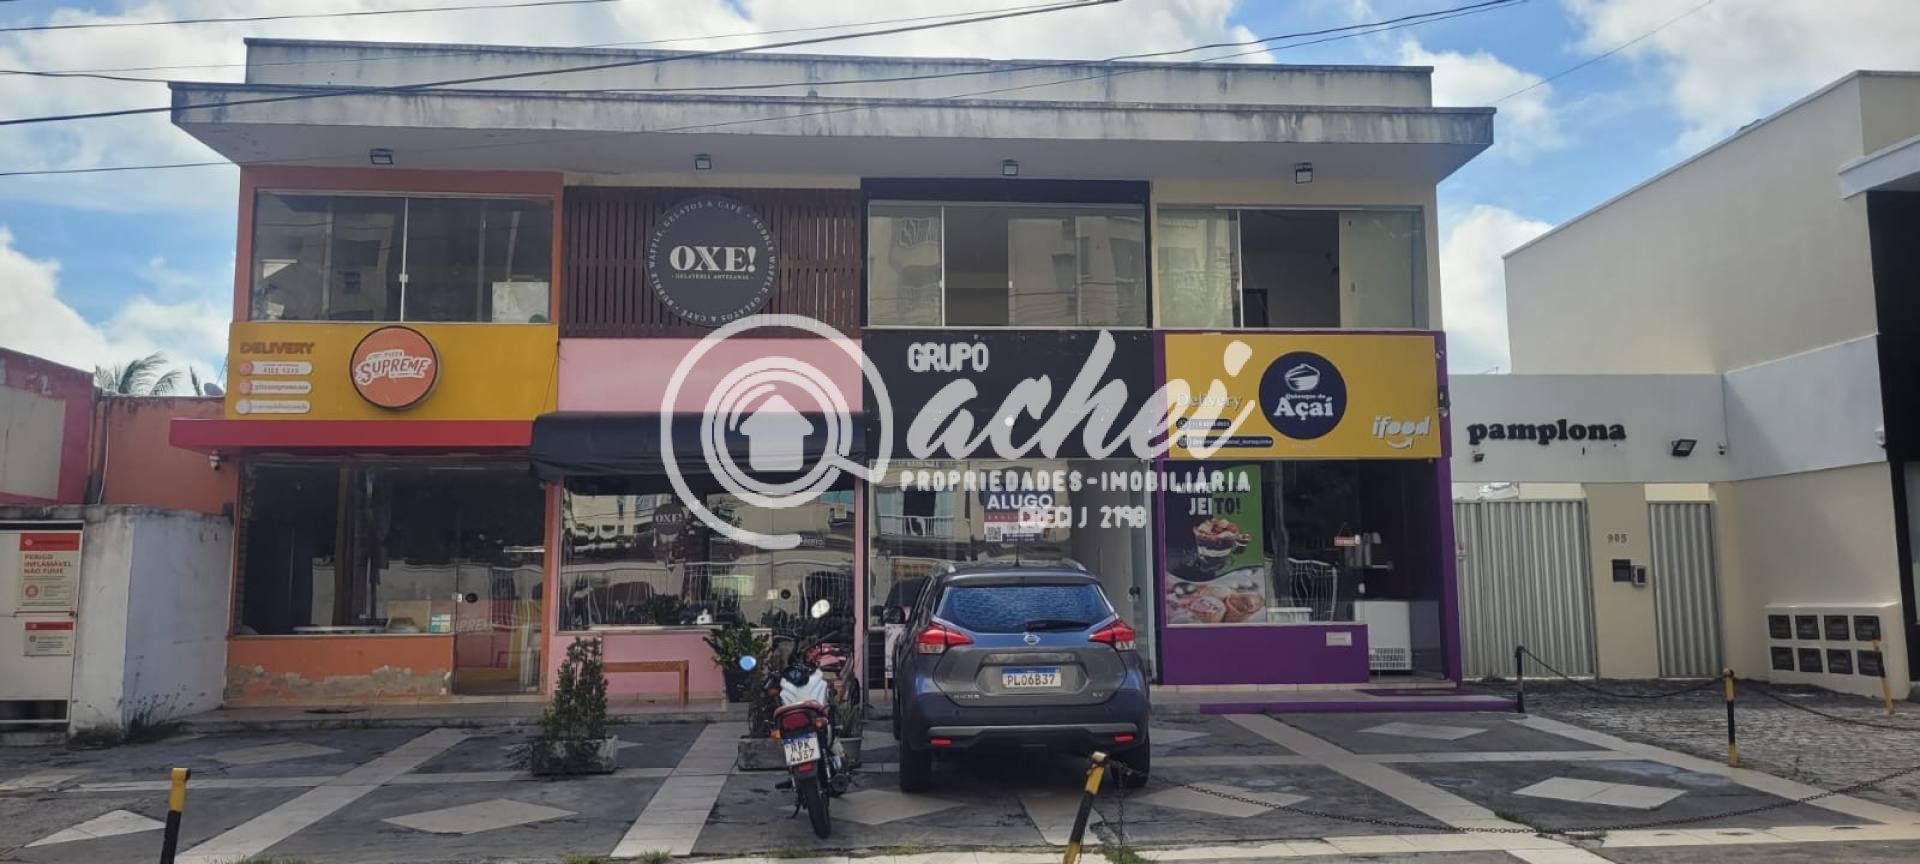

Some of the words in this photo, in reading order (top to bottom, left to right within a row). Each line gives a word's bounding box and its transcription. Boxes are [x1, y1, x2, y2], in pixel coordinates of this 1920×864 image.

[669, 245, 757, 273] OXE!
[239, 342, 315, 354] DELIVERY
[359, 357, 429, 384] SUPREME
[1273, 396, 1334, 421] Açaí
[1467, 419, 1627, 446] pamplona
[987, 494, 1054, 510] ALUGO
[1189, 497, 1241, 516] JEITO!
